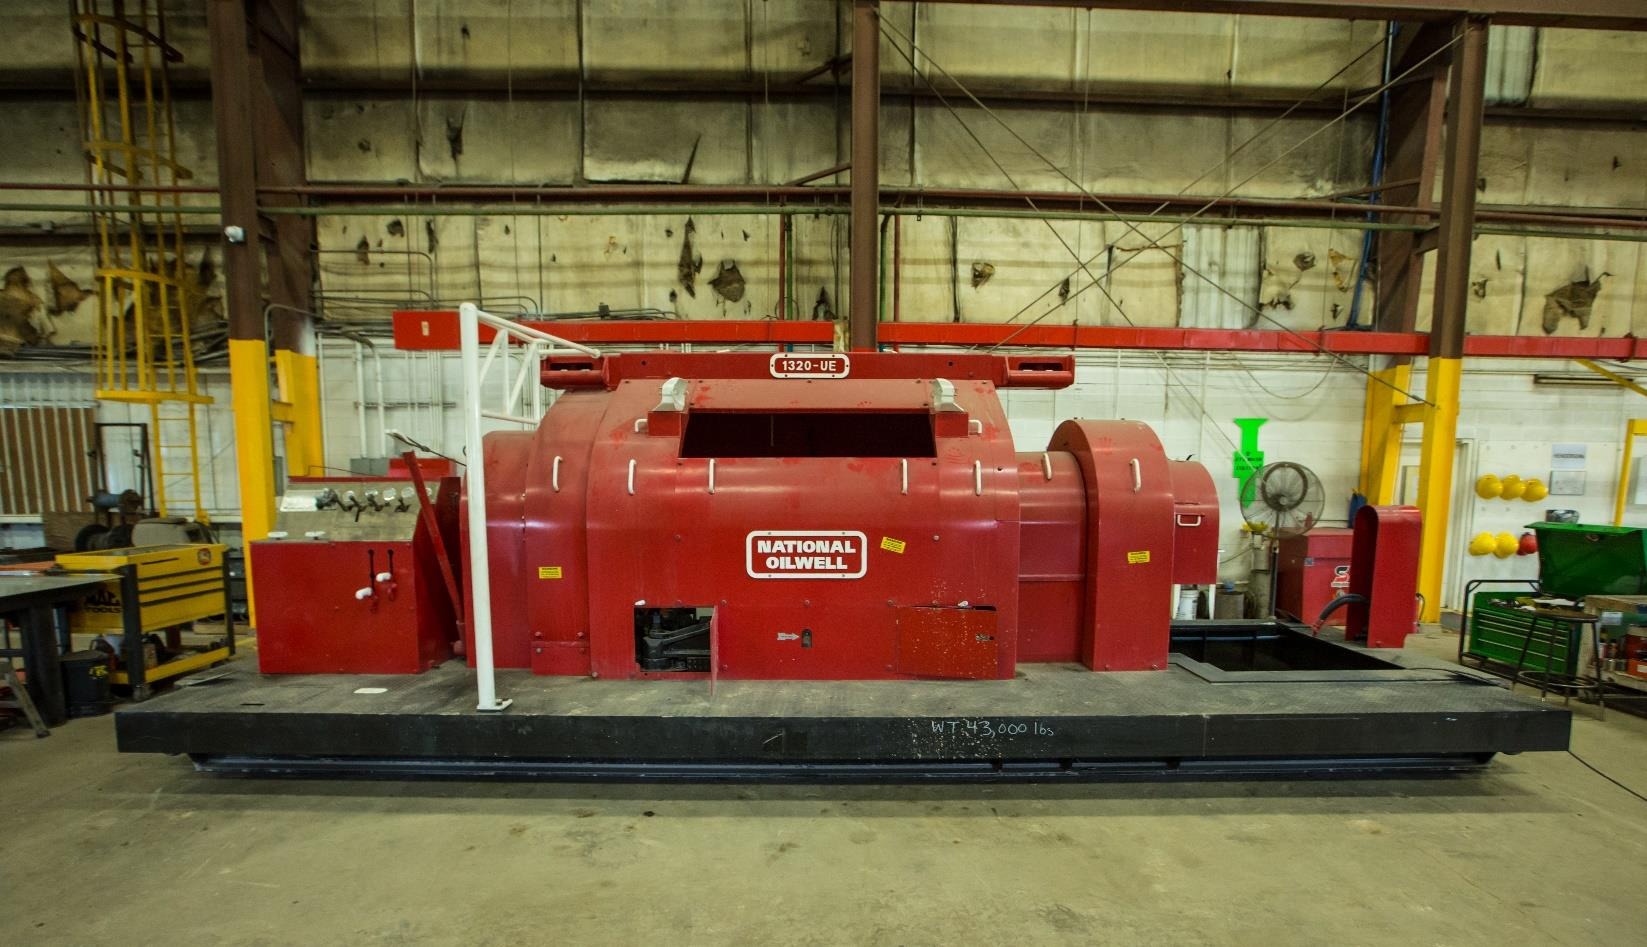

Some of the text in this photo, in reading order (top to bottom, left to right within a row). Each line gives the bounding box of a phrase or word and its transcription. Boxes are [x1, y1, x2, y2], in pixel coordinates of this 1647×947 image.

[782, 360, 837, 371] 1320-UE
[757, 540, 857, 553] NATIONAL
[765, 556, 849, 570] OILWELL
[966, 720, 1027, 738] 43,000
[1034, 722, 1054, 736] lbs
